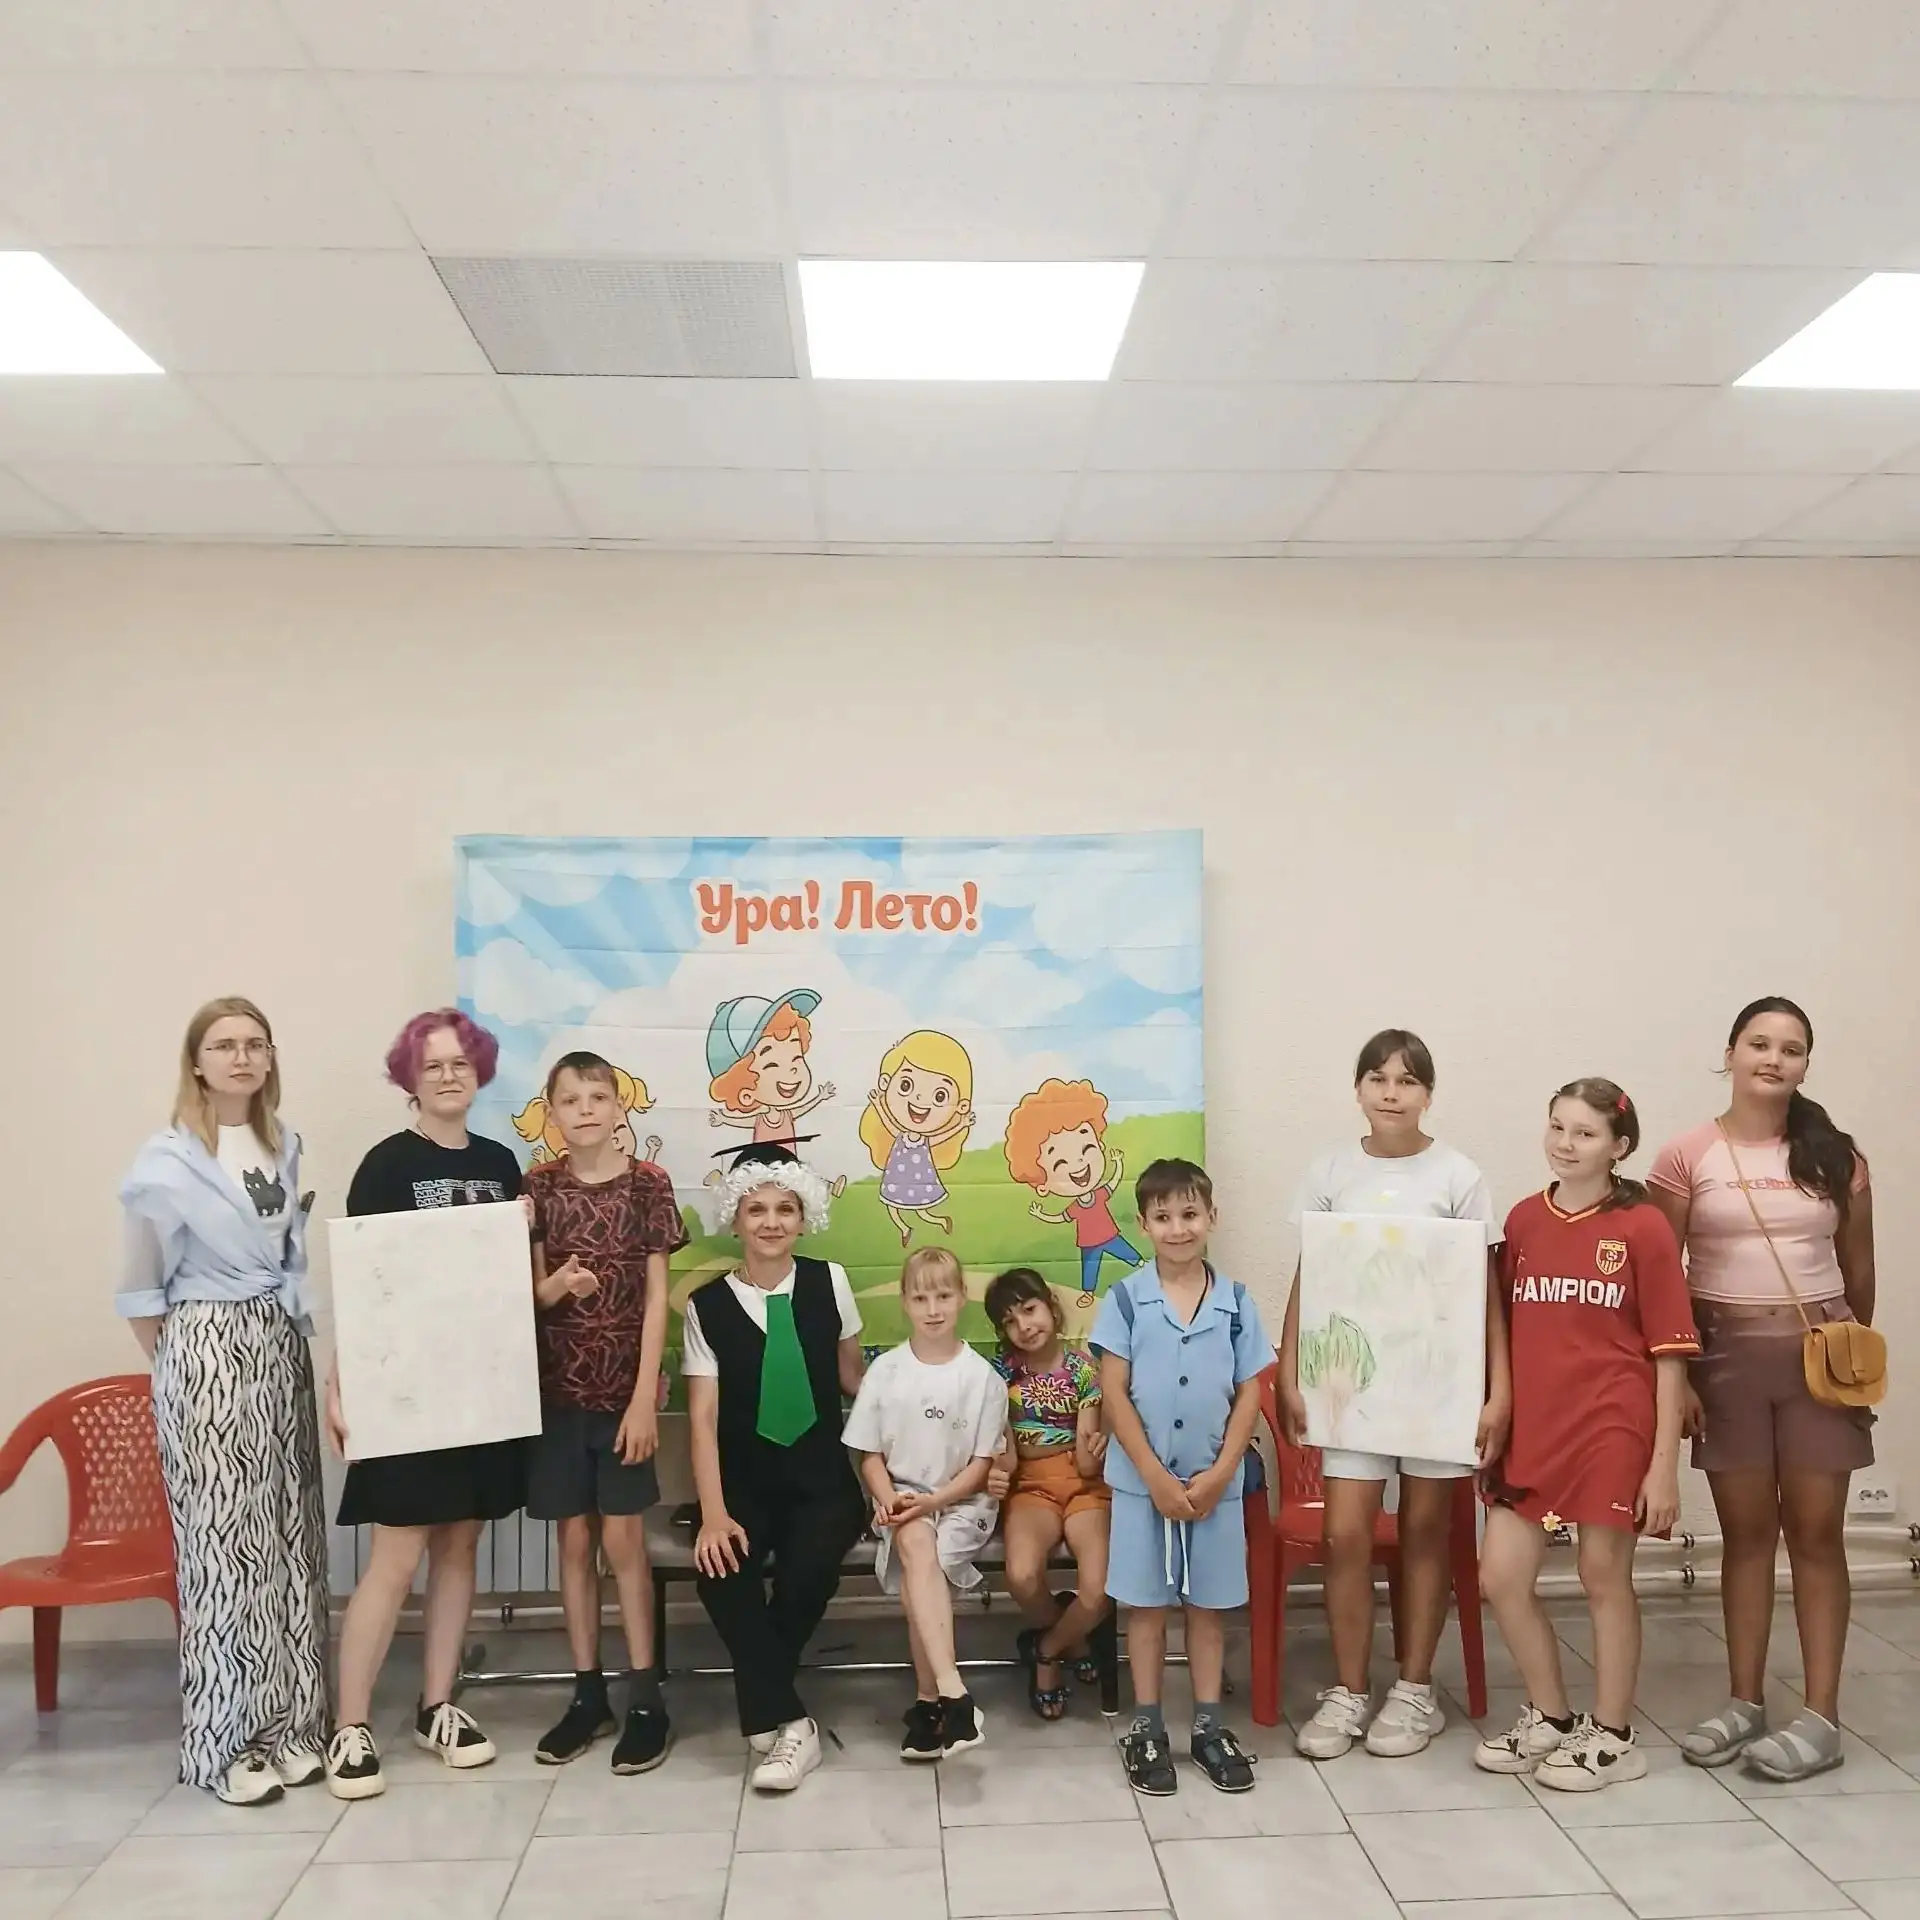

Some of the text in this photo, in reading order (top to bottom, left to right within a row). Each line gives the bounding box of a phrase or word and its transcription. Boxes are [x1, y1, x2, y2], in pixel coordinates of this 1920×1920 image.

[696, 879, 978, 945] Ура! Лето!
[1512, 1276, 1626, 1309] HAMPION
